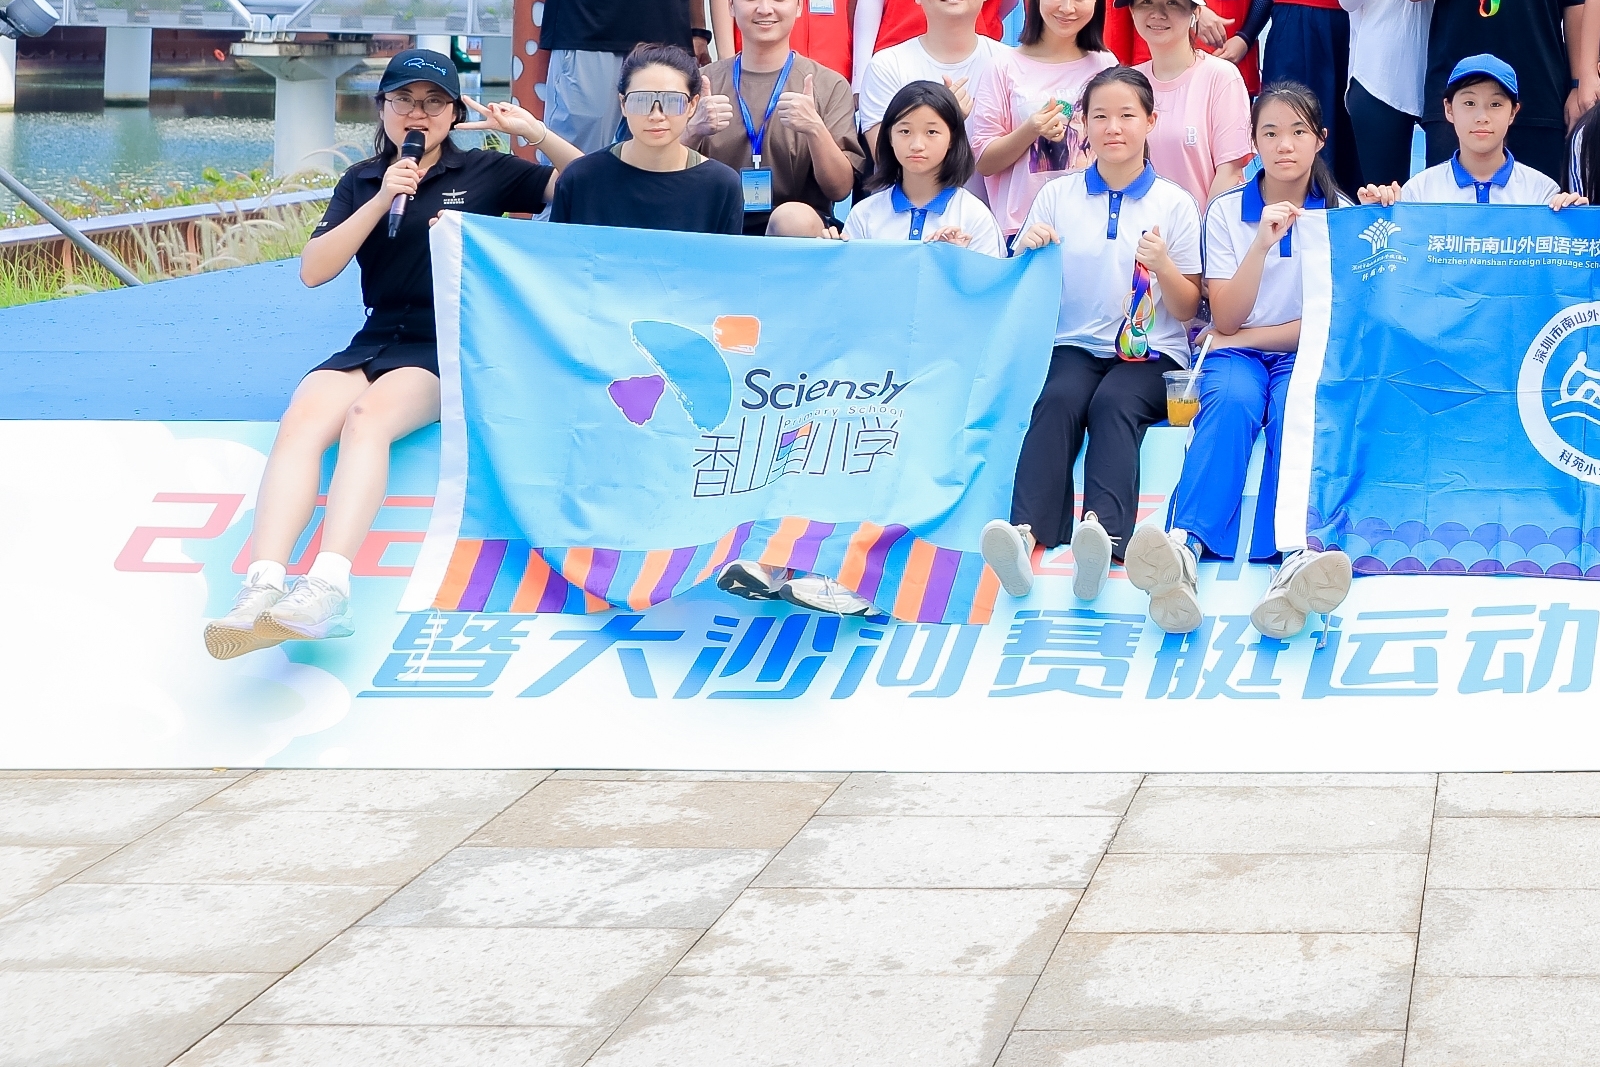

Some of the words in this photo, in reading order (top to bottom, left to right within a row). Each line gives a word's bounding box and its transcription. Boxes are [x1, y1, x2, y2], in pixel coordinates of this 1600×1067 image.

[1184, 125, 1199, 146] B
[1426, 254, 1469, 266] Shenzhen
[1469, 256, 1507, 267] Nanshan
[1508, 257, 1541, 268] Foreign
[1542, 257, 1584, 270] Language
[741, 368, 914, 411] Sciensly
[783, 406, 840, 428] Primary
[847, 405, 906, 419] School
